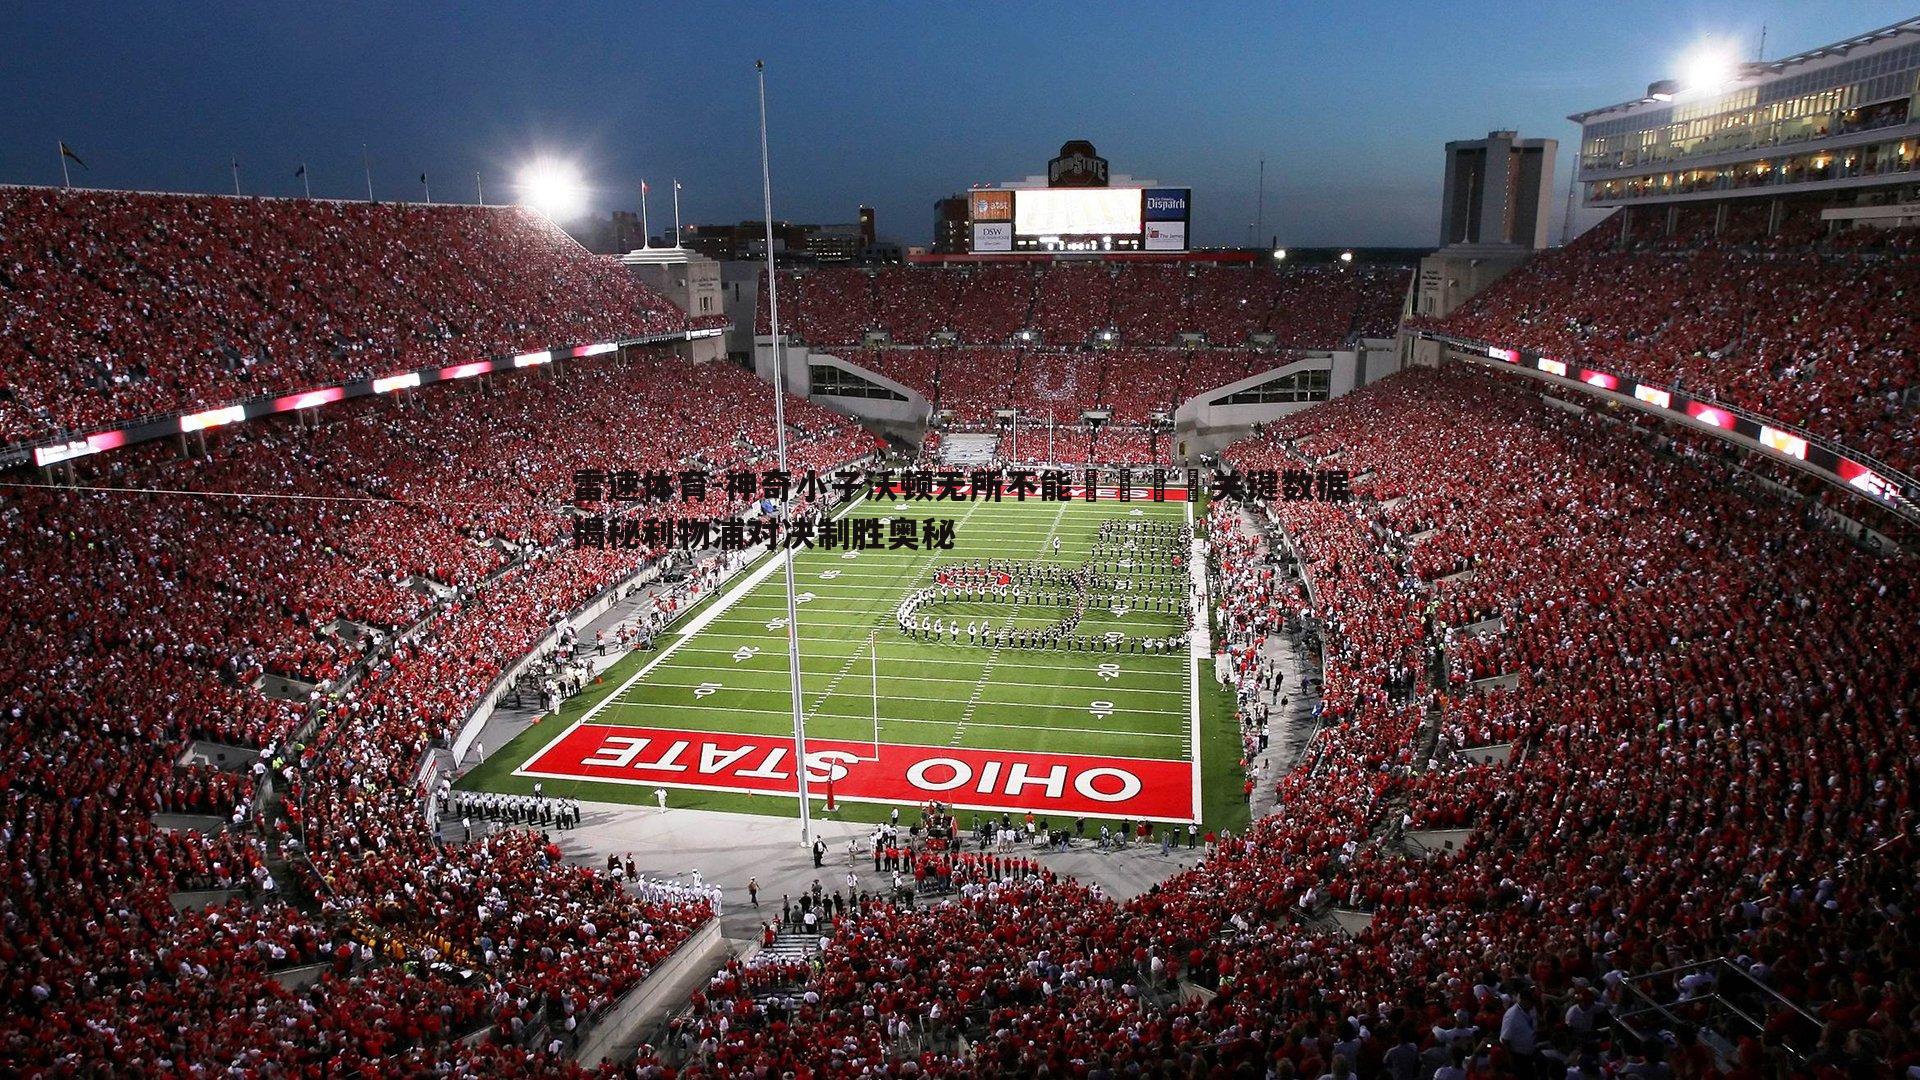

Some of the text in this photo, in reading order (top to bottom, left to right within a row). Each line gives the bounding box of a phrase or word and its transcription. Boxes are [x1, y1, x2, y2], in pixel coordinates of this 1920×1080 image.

[1147, 197, 1185, 210] Dispatch
[983, 228, 1002, 236] DSW
[1098, 664, 1120, 677] 20
[1089, 701, 1114, 715] 10
[580, 736, 1142, 802] OHIO STATE
